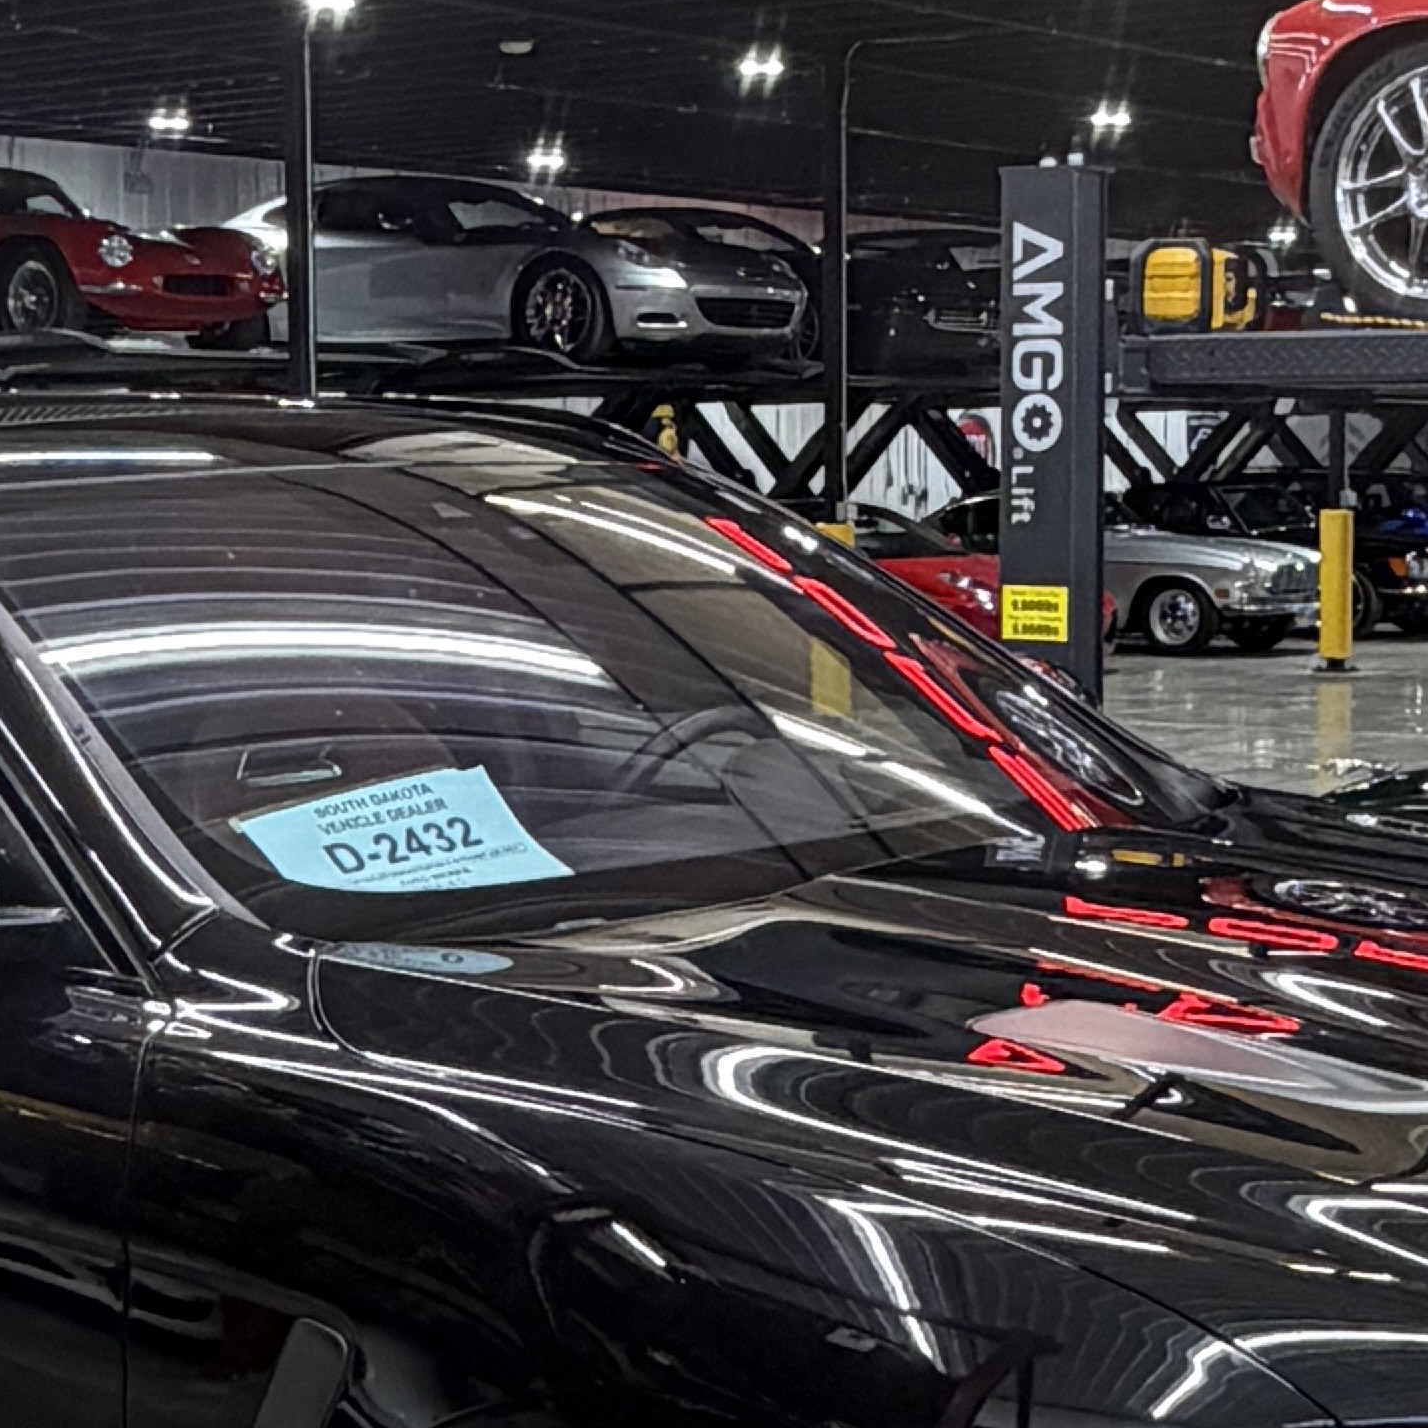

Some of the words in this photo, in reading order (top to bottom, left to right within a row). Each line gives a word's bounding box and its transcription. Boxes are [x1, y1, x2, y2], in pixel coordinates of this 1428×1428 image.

[314, 798, 369, 818] SOUTH
[369, 783, 433, 805] DAKOTA
[317, 811, 385, 835] VEHICLE
[387, 797, 447, 821] DEALER
[323, 816, 484, 875] D-2432
